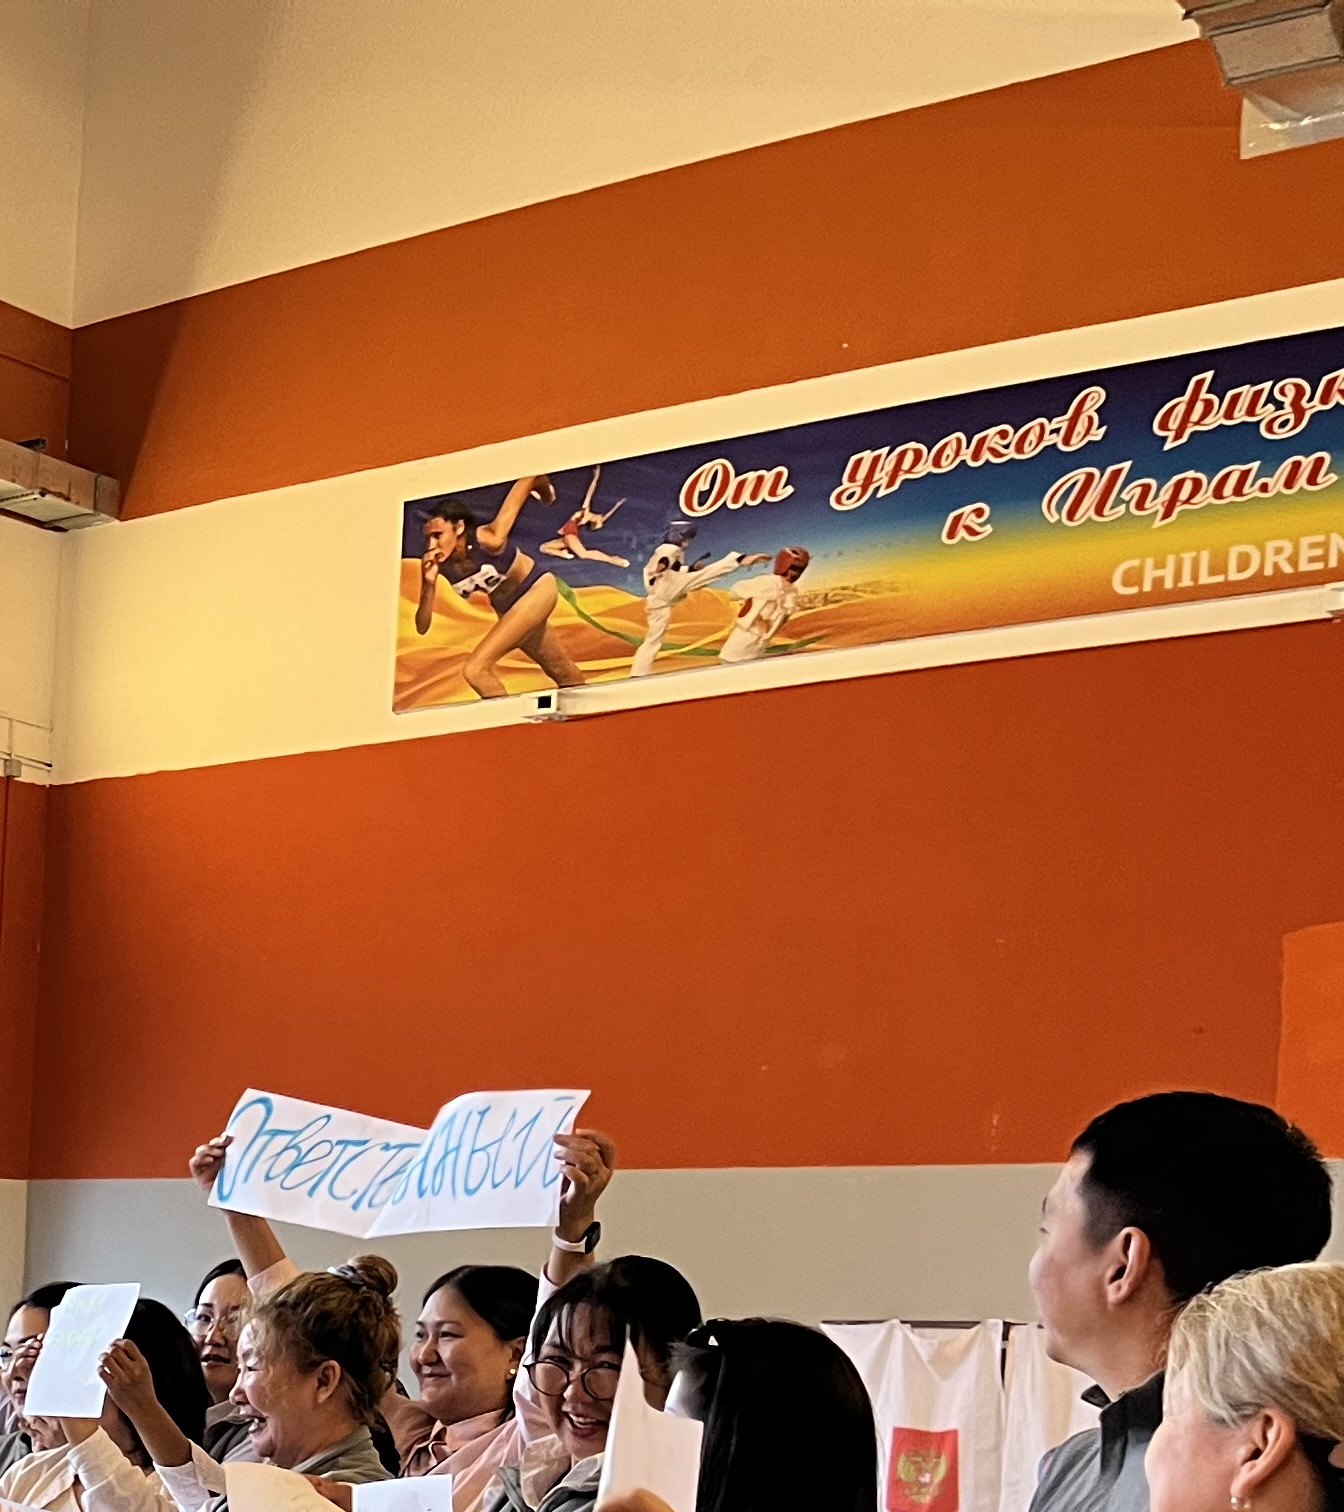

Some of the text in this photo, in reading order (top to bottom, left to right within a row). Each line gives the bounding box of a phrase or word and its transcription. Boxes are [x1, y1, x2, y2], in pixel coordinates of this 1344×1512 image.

[679, 457, 792, 519] От
[830, 386, 1107, 511] уроков
[941, 451, 1338, 545] к Играм
[218, 1096, 576, 1212] Ответстнный
